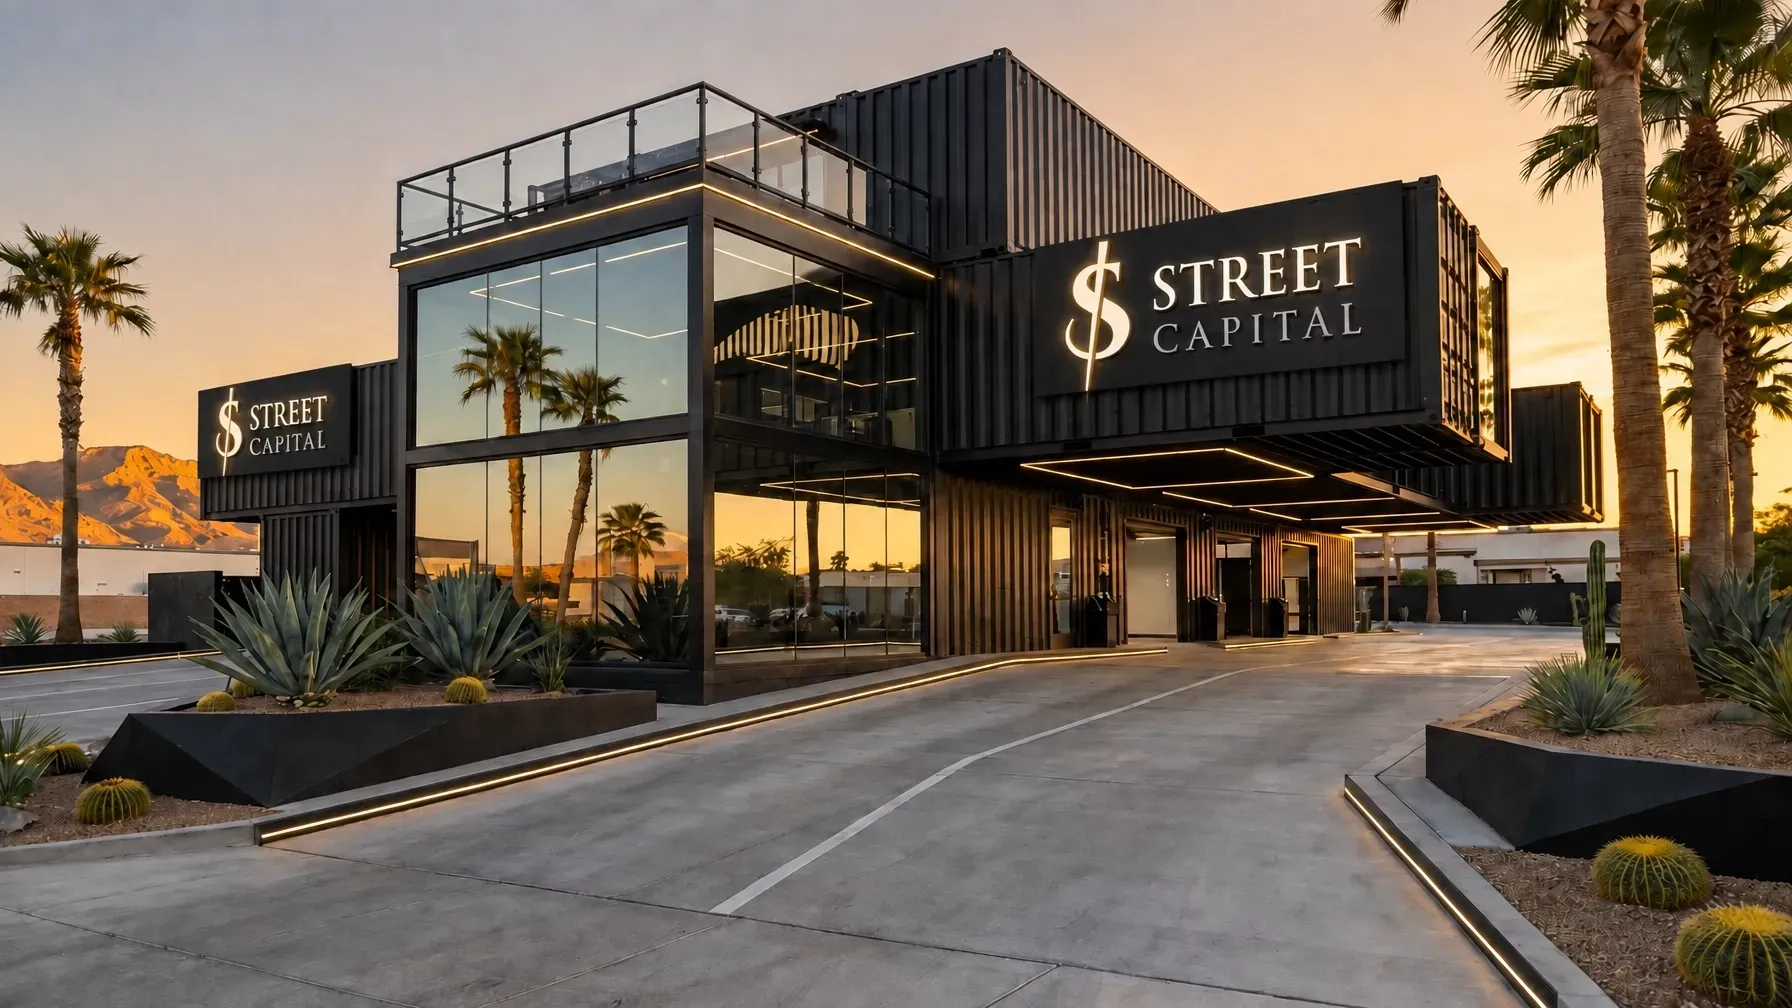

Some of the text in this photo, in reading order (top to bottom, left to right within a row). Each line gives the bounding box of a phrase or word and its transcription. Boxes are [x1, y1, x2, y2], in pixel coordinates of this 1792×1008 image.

[1153, 237, 1362, 311] STREET
[1153, 302, 1362, 354] CAPITAL
[250, 395, 328, 430] STREET
[250, 430, 326, 456] CAPITAL
